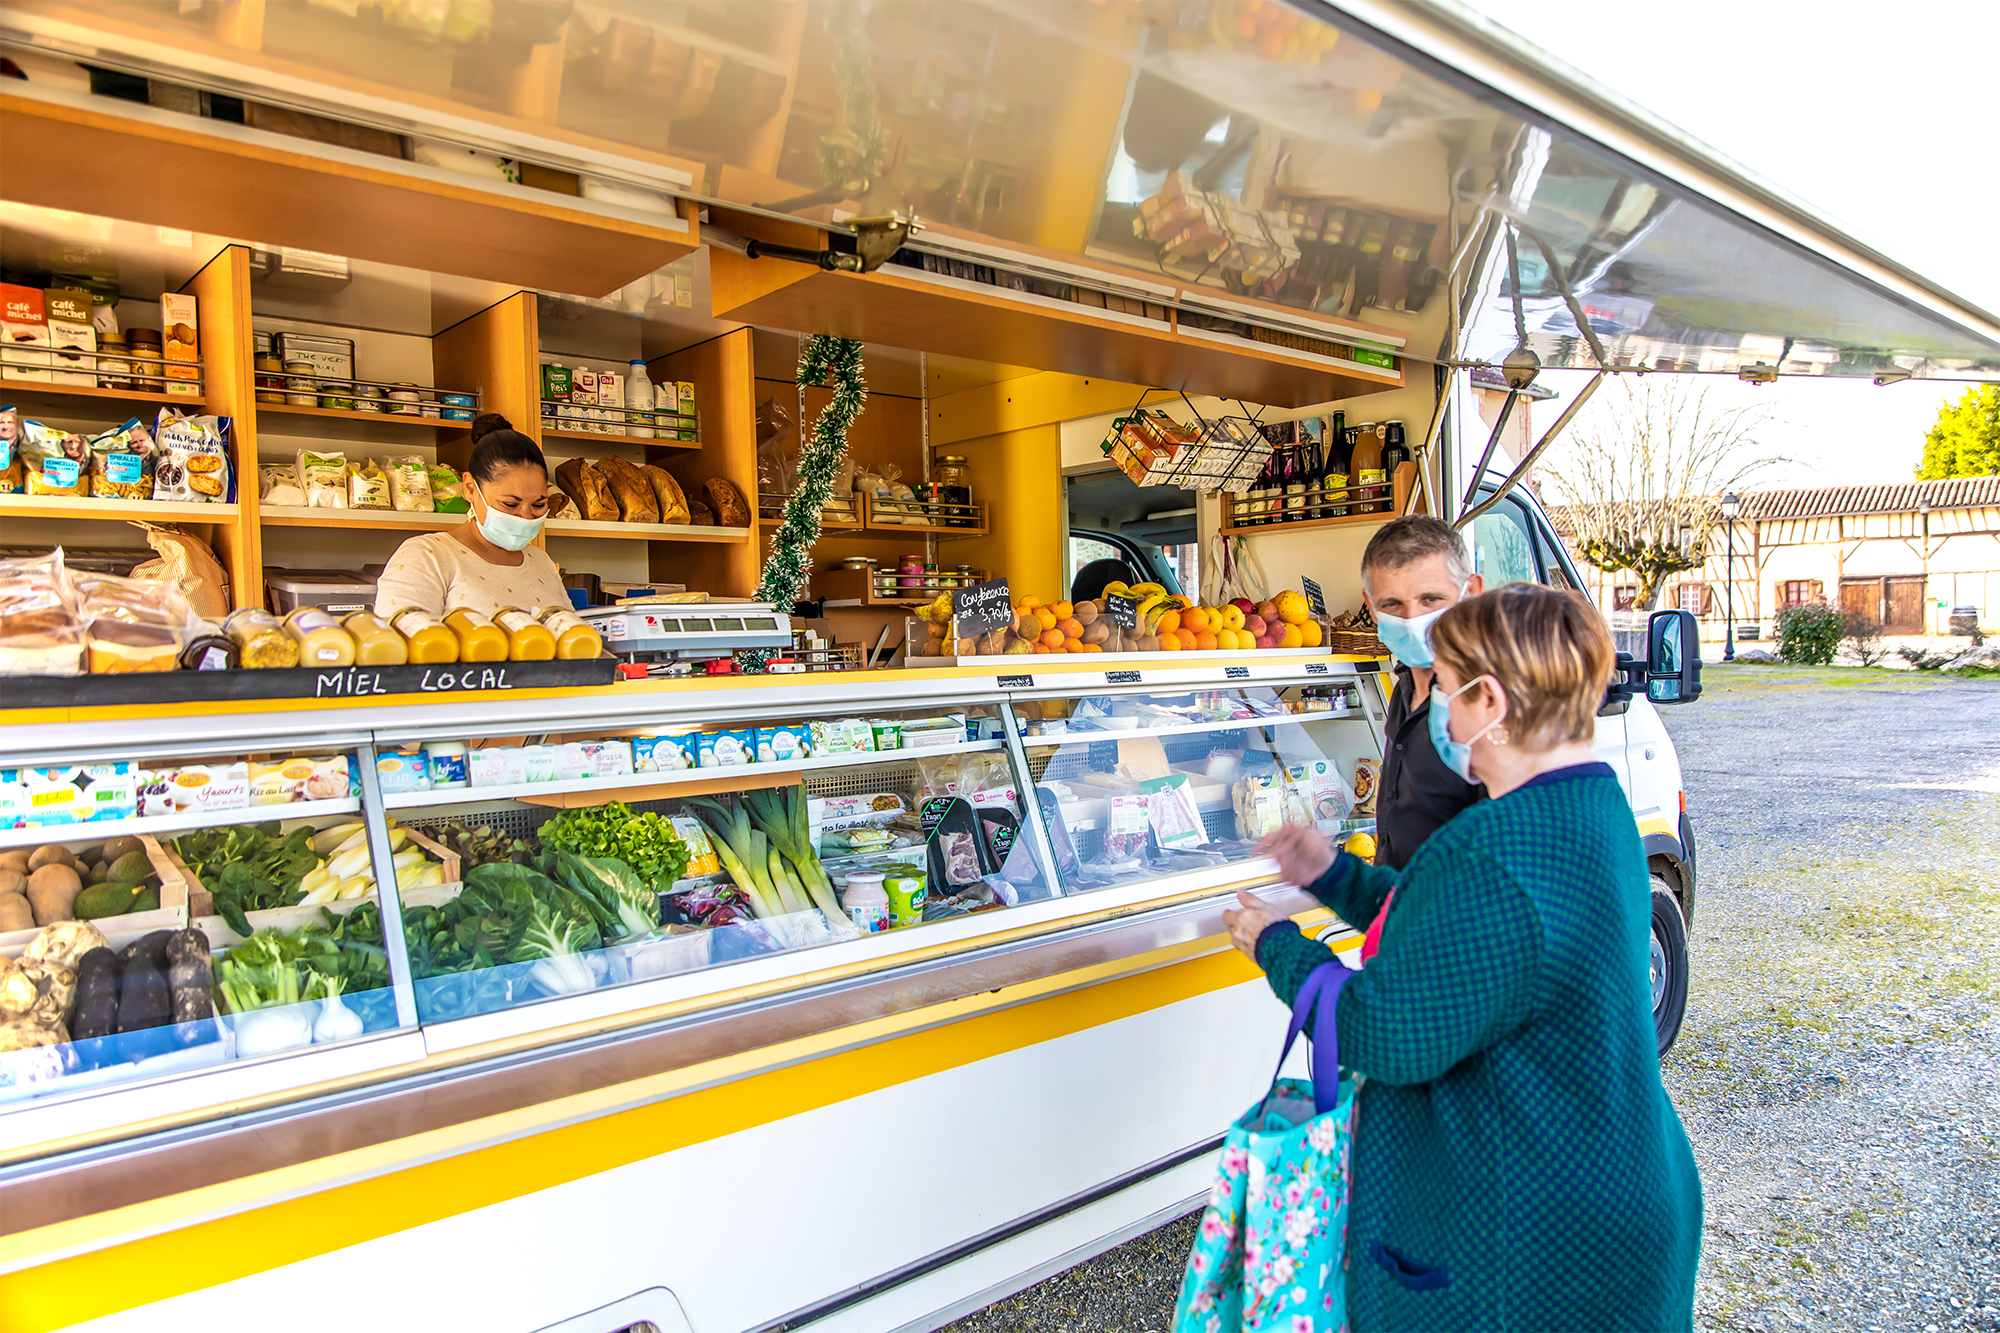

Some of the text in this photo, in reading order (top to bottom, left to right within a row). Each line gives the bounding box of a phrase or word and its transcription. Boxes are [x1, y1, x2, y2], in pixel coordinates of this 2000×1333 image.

[7, 302, 30, 312] café
[52, 300, 75, 310] café
[7, 310, 42, 321] michel
[52, 308, 87, 319] michel
[322, 356, 347, 364] VERT
[551, 382, 568, 392] Reis
[574, 392, 588, 400] OAT
[109, 454, 139, 463] SPIRALES
[420, 668, 513, 691] LOCAL
[596, 752, 623, 762] Brassé
[196, 784, 245, 802] Yaourts
[249, 788, 264, 796] Riz
[279, 785, 297, 794] Lait
[924, 811, 942, 821] Faget
